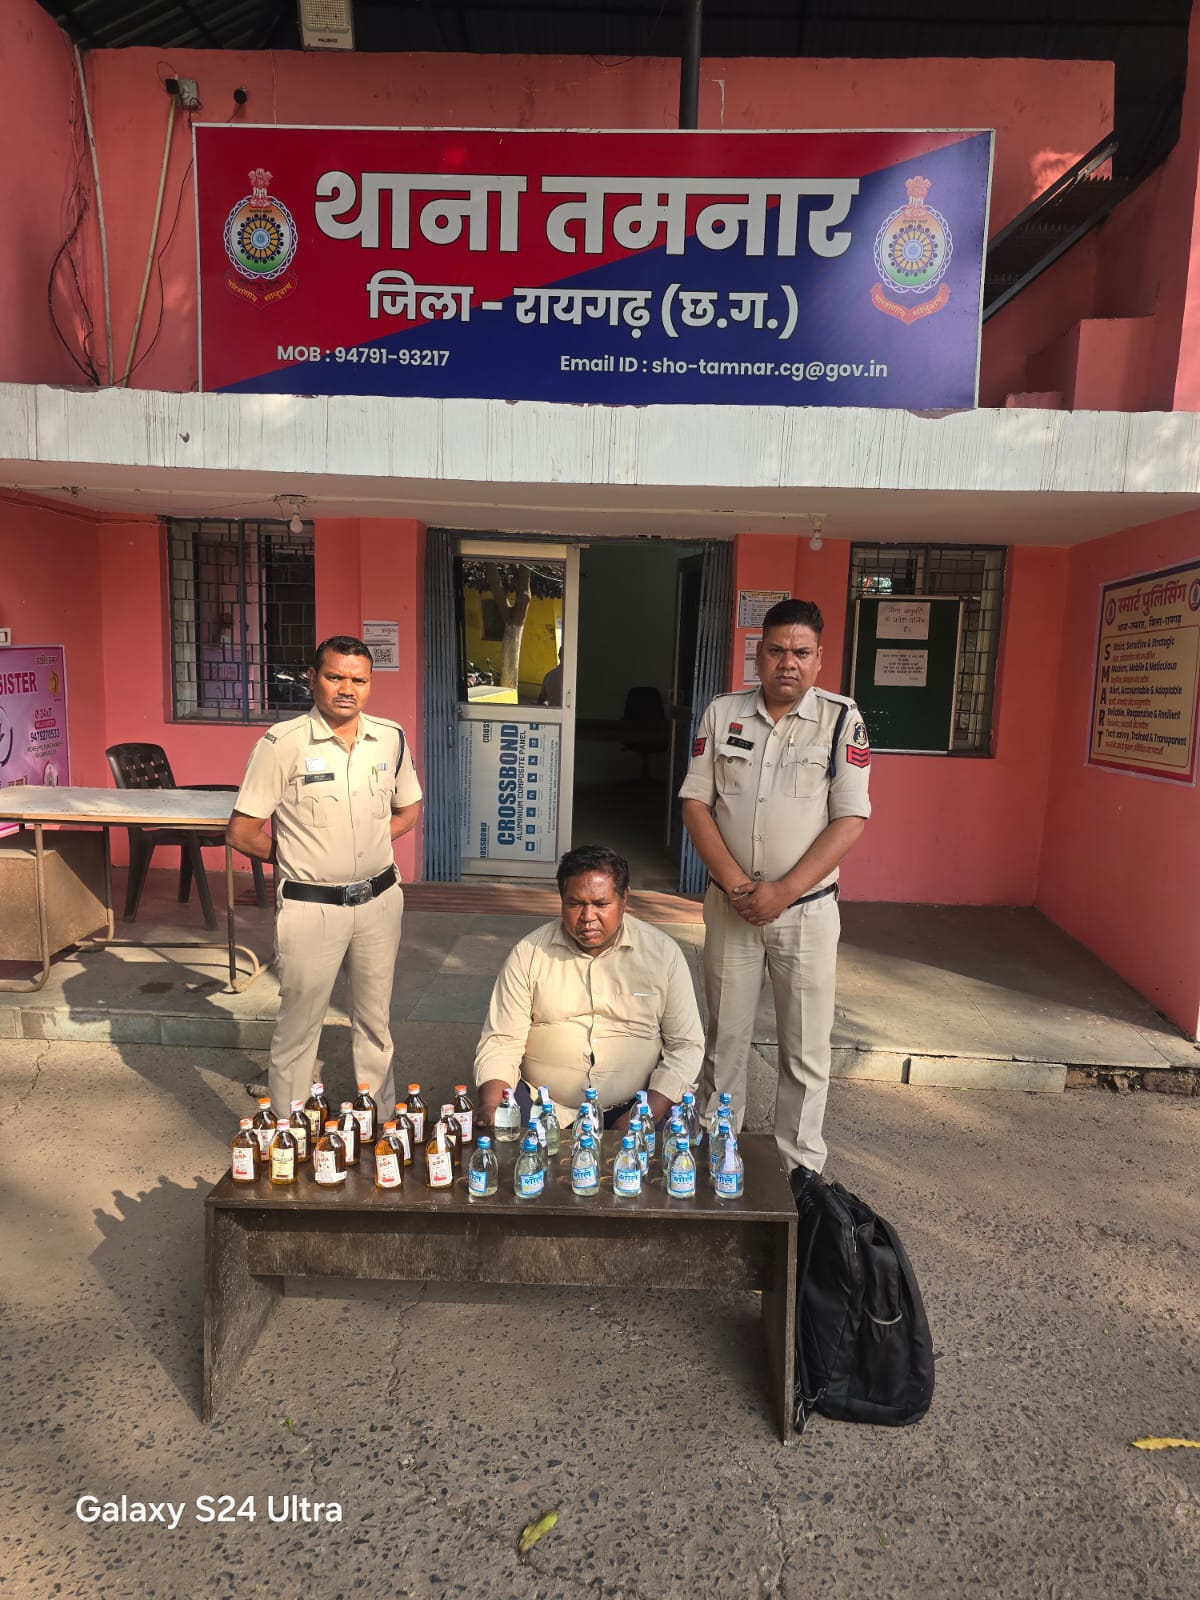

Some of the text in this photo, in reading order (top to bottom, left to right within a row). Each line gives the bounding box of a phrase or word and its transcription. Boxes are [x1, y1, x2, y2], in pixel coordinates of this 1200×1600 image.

[314, 170, 861, 258] थाना तमनार
[366, 269, 474, 322] जिला
[513, 287, 653, 339] रायगढ़
[661, 283, 799, 340] (छ.ग.)
[334, 346, 450, 367] 94791-93217
[560, 355, 614, 372] Email
[652, 359, 888, 381] sho-tamnar.cg@gov.in
[1104, 643, 1111, 661] S
[1101, 665, 1110, 683] M
[1100, 687, 1107, 705] A
[1099, 709, 1106, 727] R
[1098, 731, 1104, 747] T
[497, 724, 519, 846] CROSSBOND
[516, 729, 527, 841] ALUMINIUM COMPOSITE PANEL
